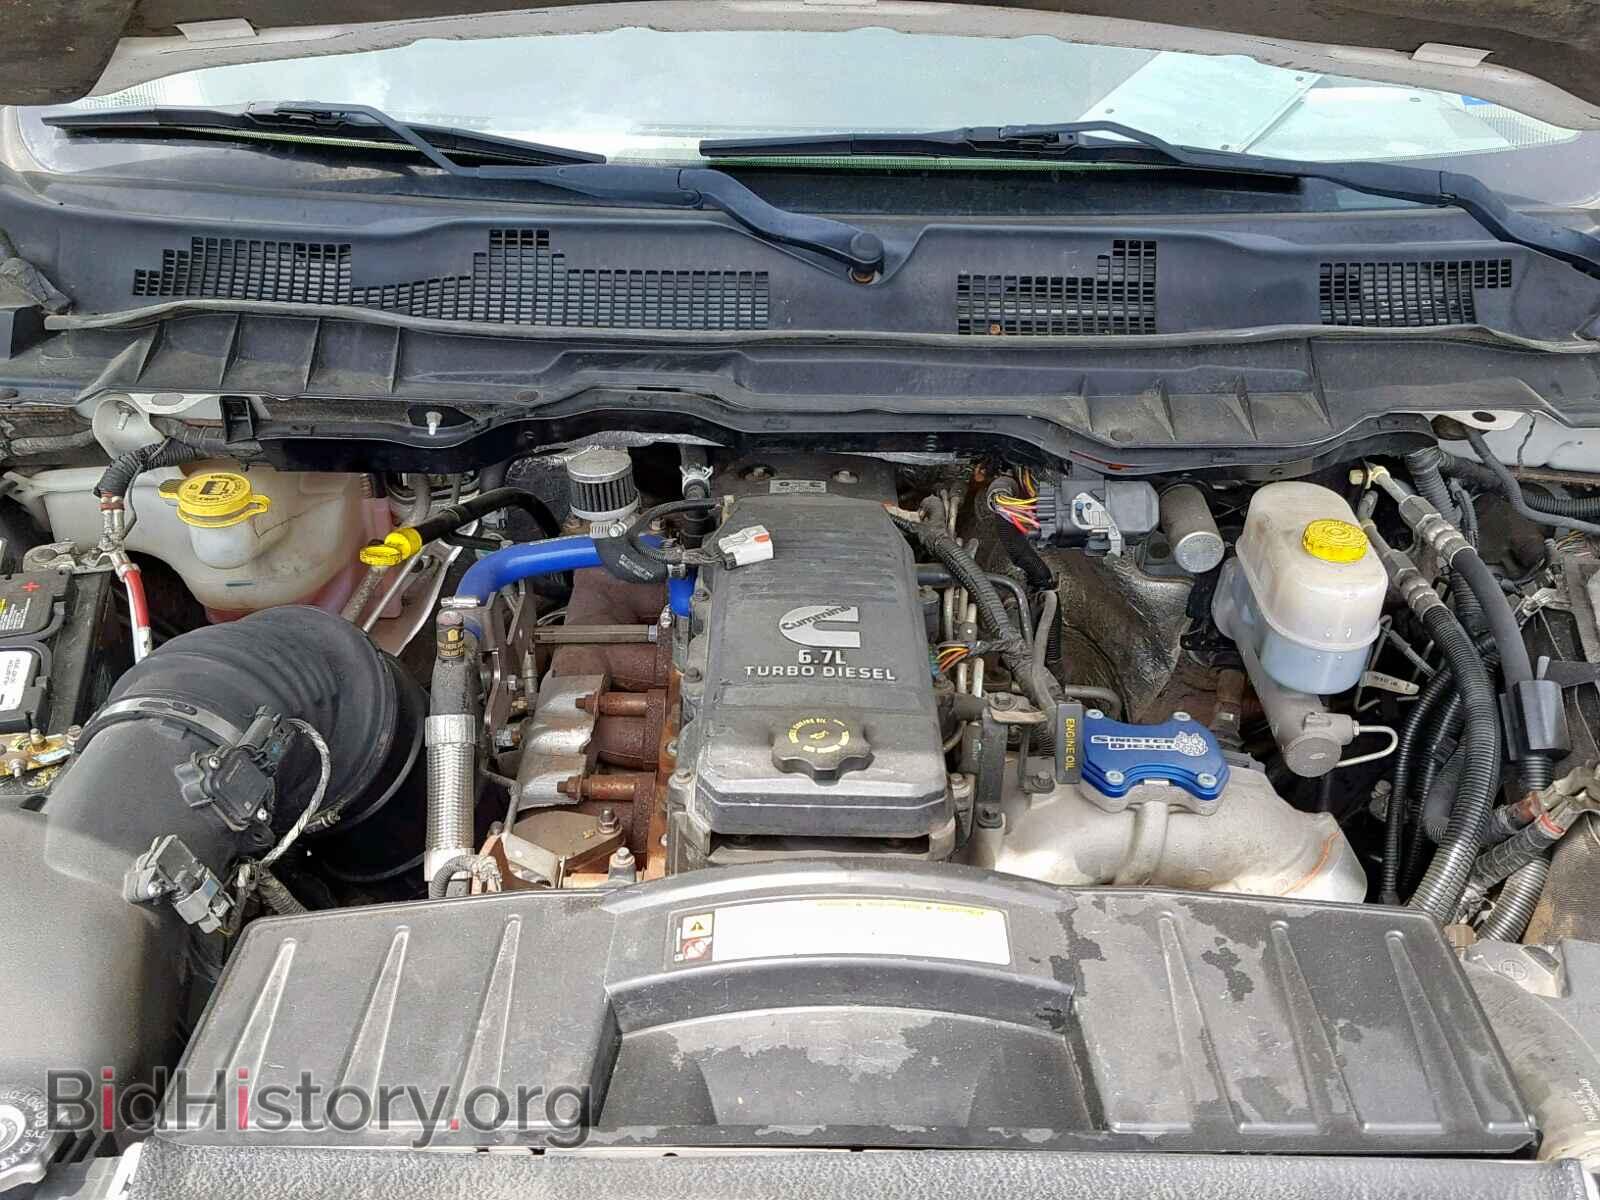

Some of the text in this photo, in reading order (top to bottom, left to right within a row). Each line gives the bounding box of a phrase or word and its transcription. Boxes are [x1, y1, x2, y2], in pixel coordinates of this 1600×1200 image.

[798, 650, 847, 665] 6.7L
[745, 665, 896, 681] TURBO DIESEL
[1065, 718, 1076, 771] ENGINE OIL
